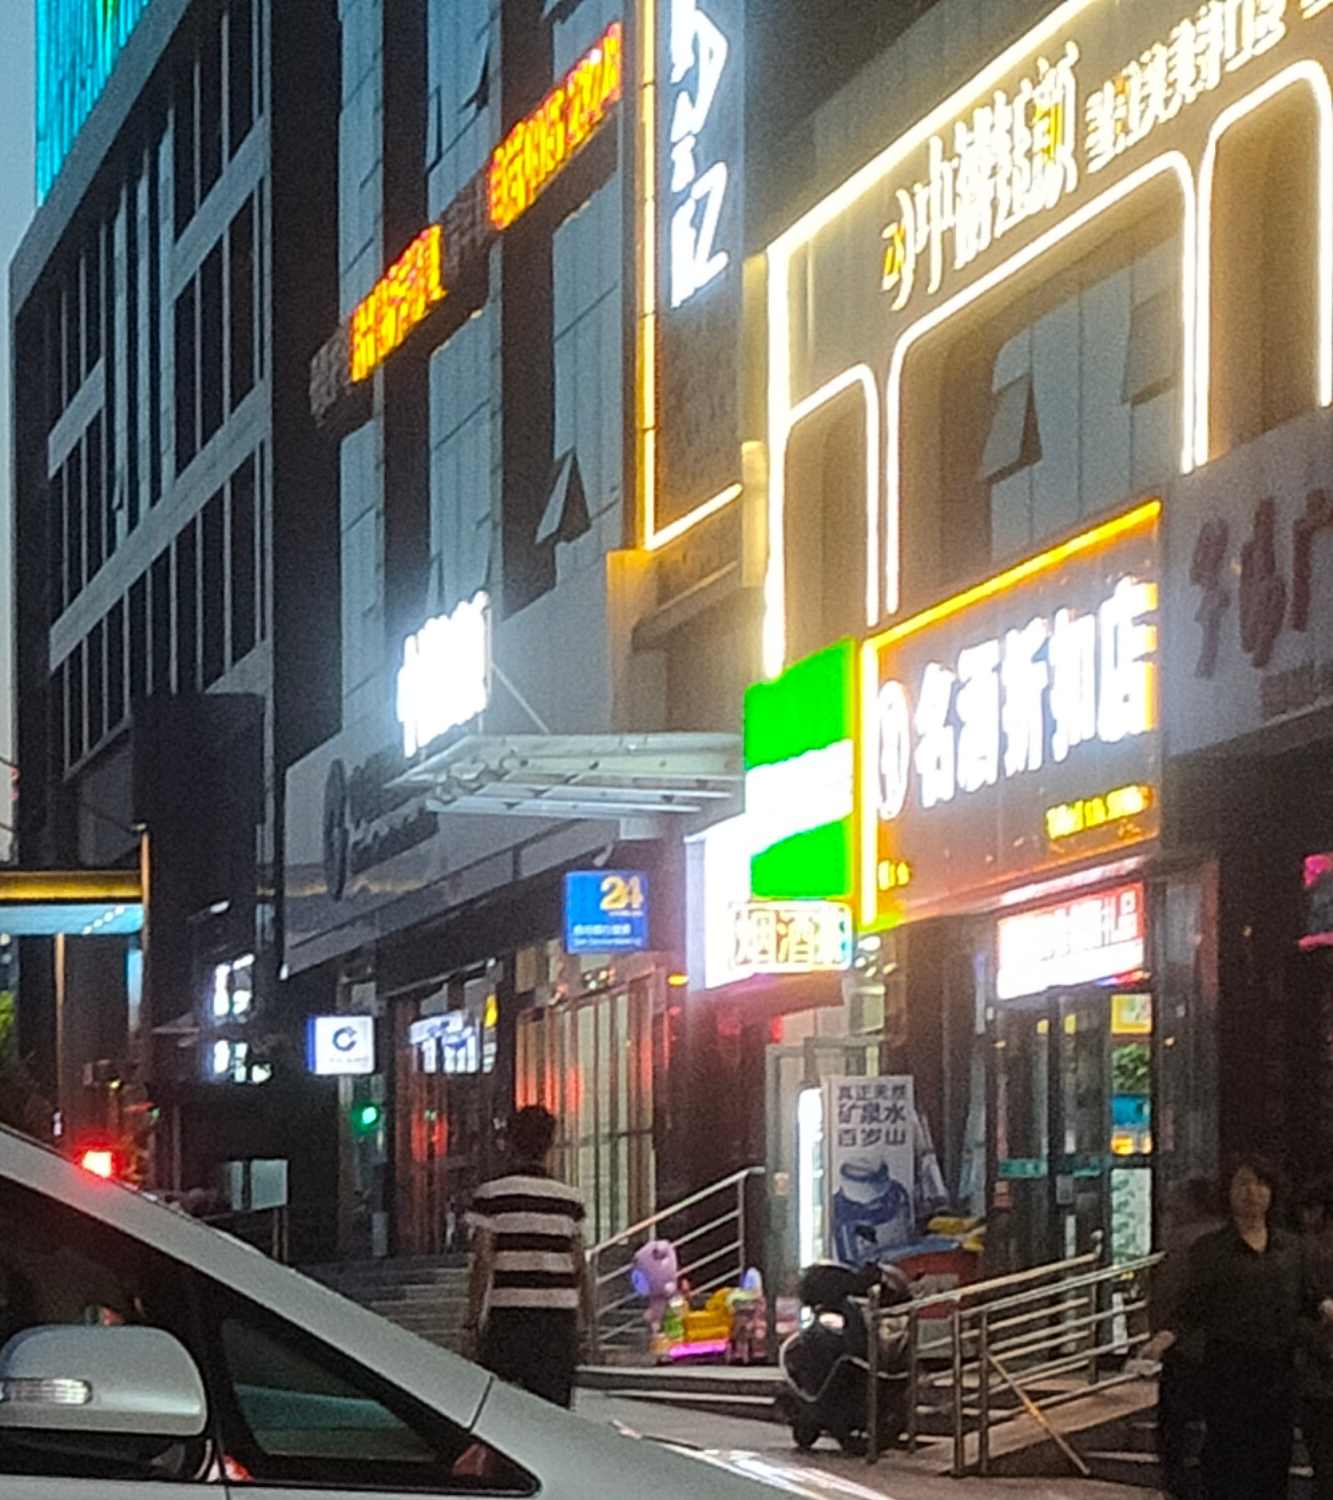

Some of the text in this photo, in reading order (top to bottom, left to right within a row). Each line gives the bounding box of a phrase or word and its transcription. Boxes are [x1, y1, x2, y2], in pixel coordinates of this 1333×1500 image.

[599, 876, 643, 910] 24
[838, 1128, 906, 1147] 百岁山
